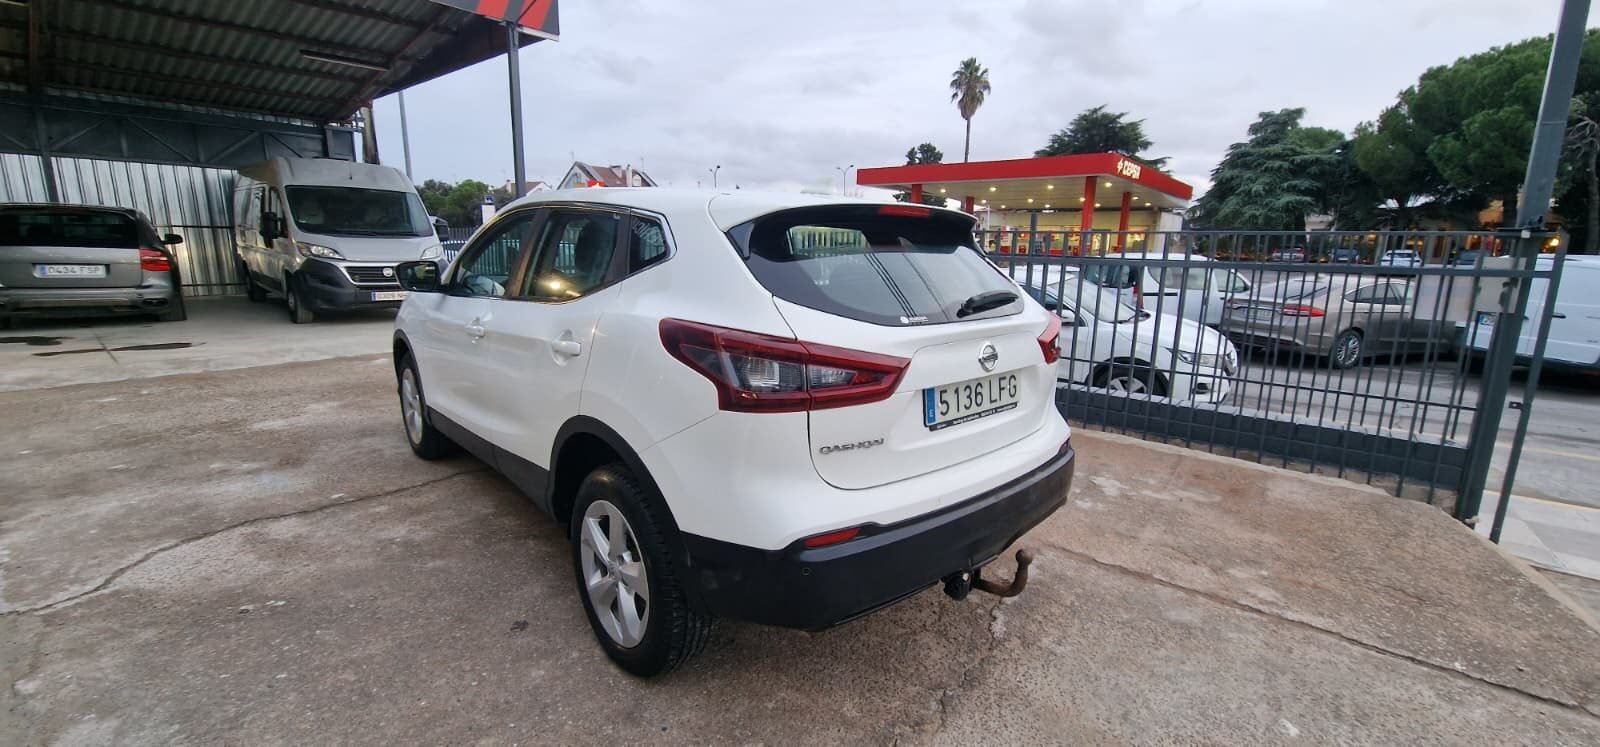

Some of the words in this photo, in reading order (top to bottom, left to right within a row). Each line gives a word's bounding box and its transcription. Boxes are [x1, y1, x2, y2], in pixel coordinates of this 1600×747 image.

[1122, 160, 1142, 180] CEPSA
[939, 382, 984, 416] 5136
[988, 374, 1017, 404] LFG
[819, 438, 884, 455] QASHQAI
